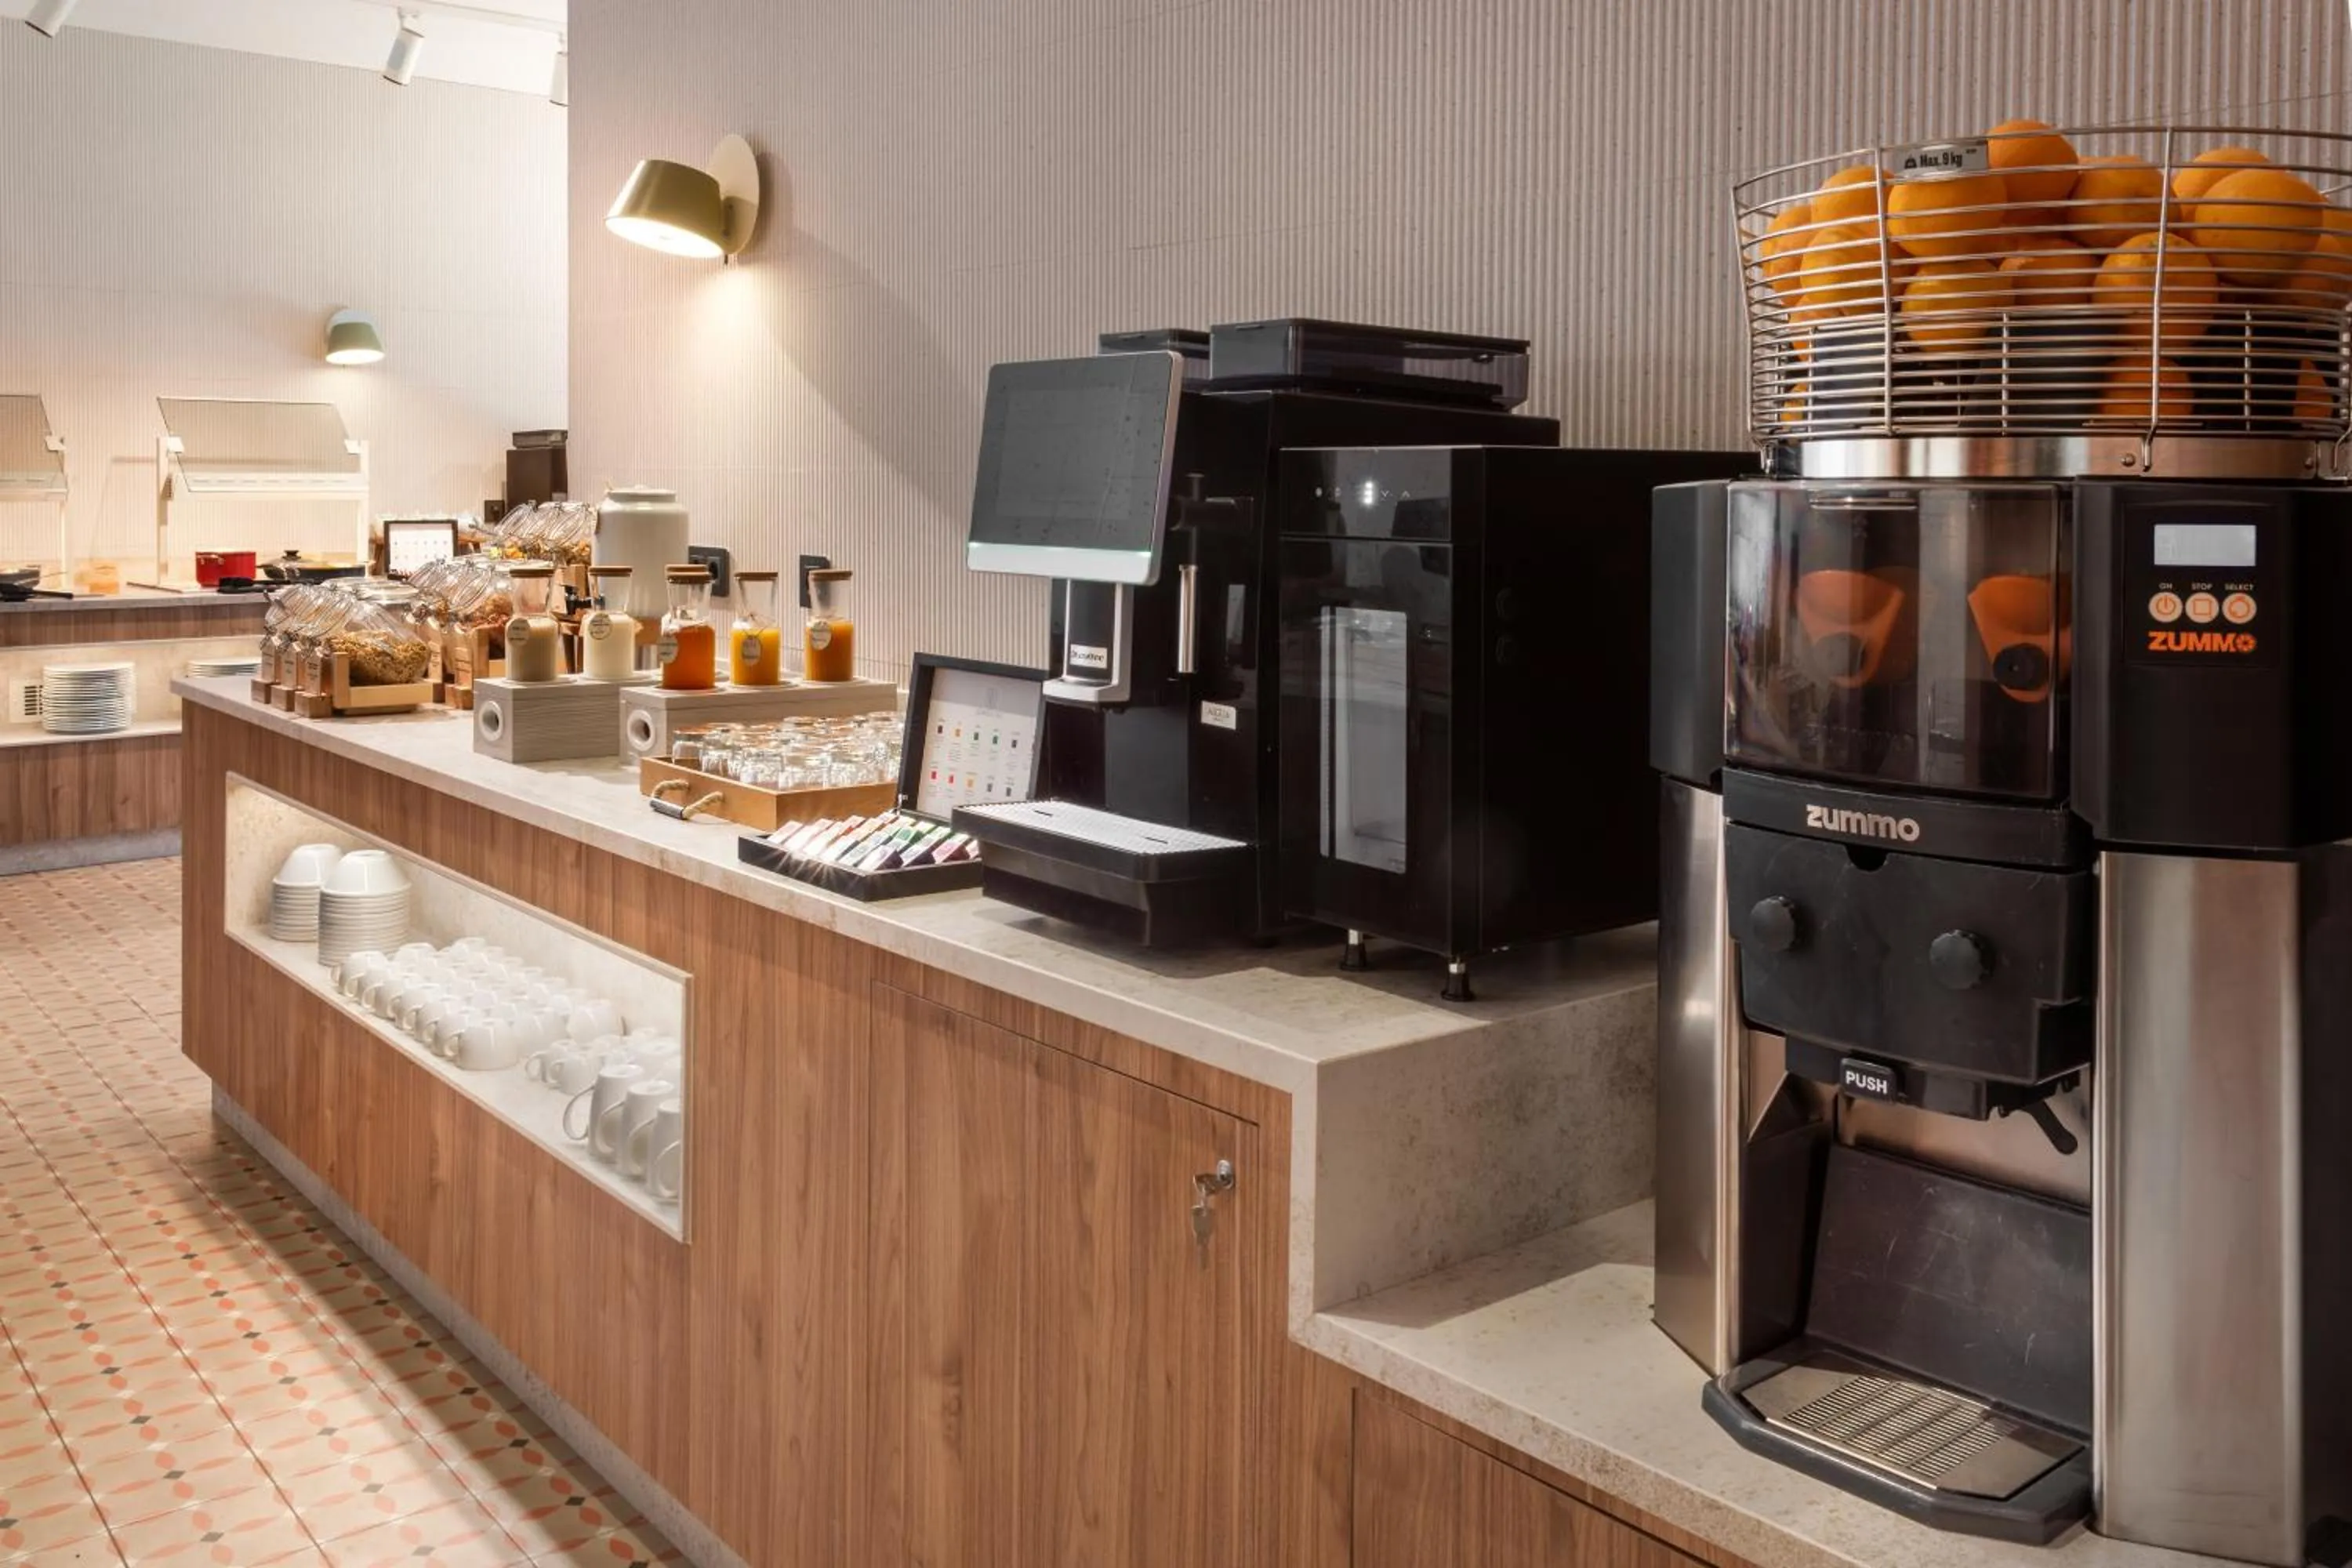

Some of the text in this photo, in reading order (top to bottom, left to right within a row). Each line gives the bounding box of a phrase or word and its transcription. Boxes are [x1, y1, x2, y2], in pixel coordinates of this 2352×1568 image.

[1942, 152, 1949, 165] 9
[1951, 151, 1962, 168] kg
[1806, 804, 1920, 841] zummo
[1846, 1070, 1888, 1094] PUSH
